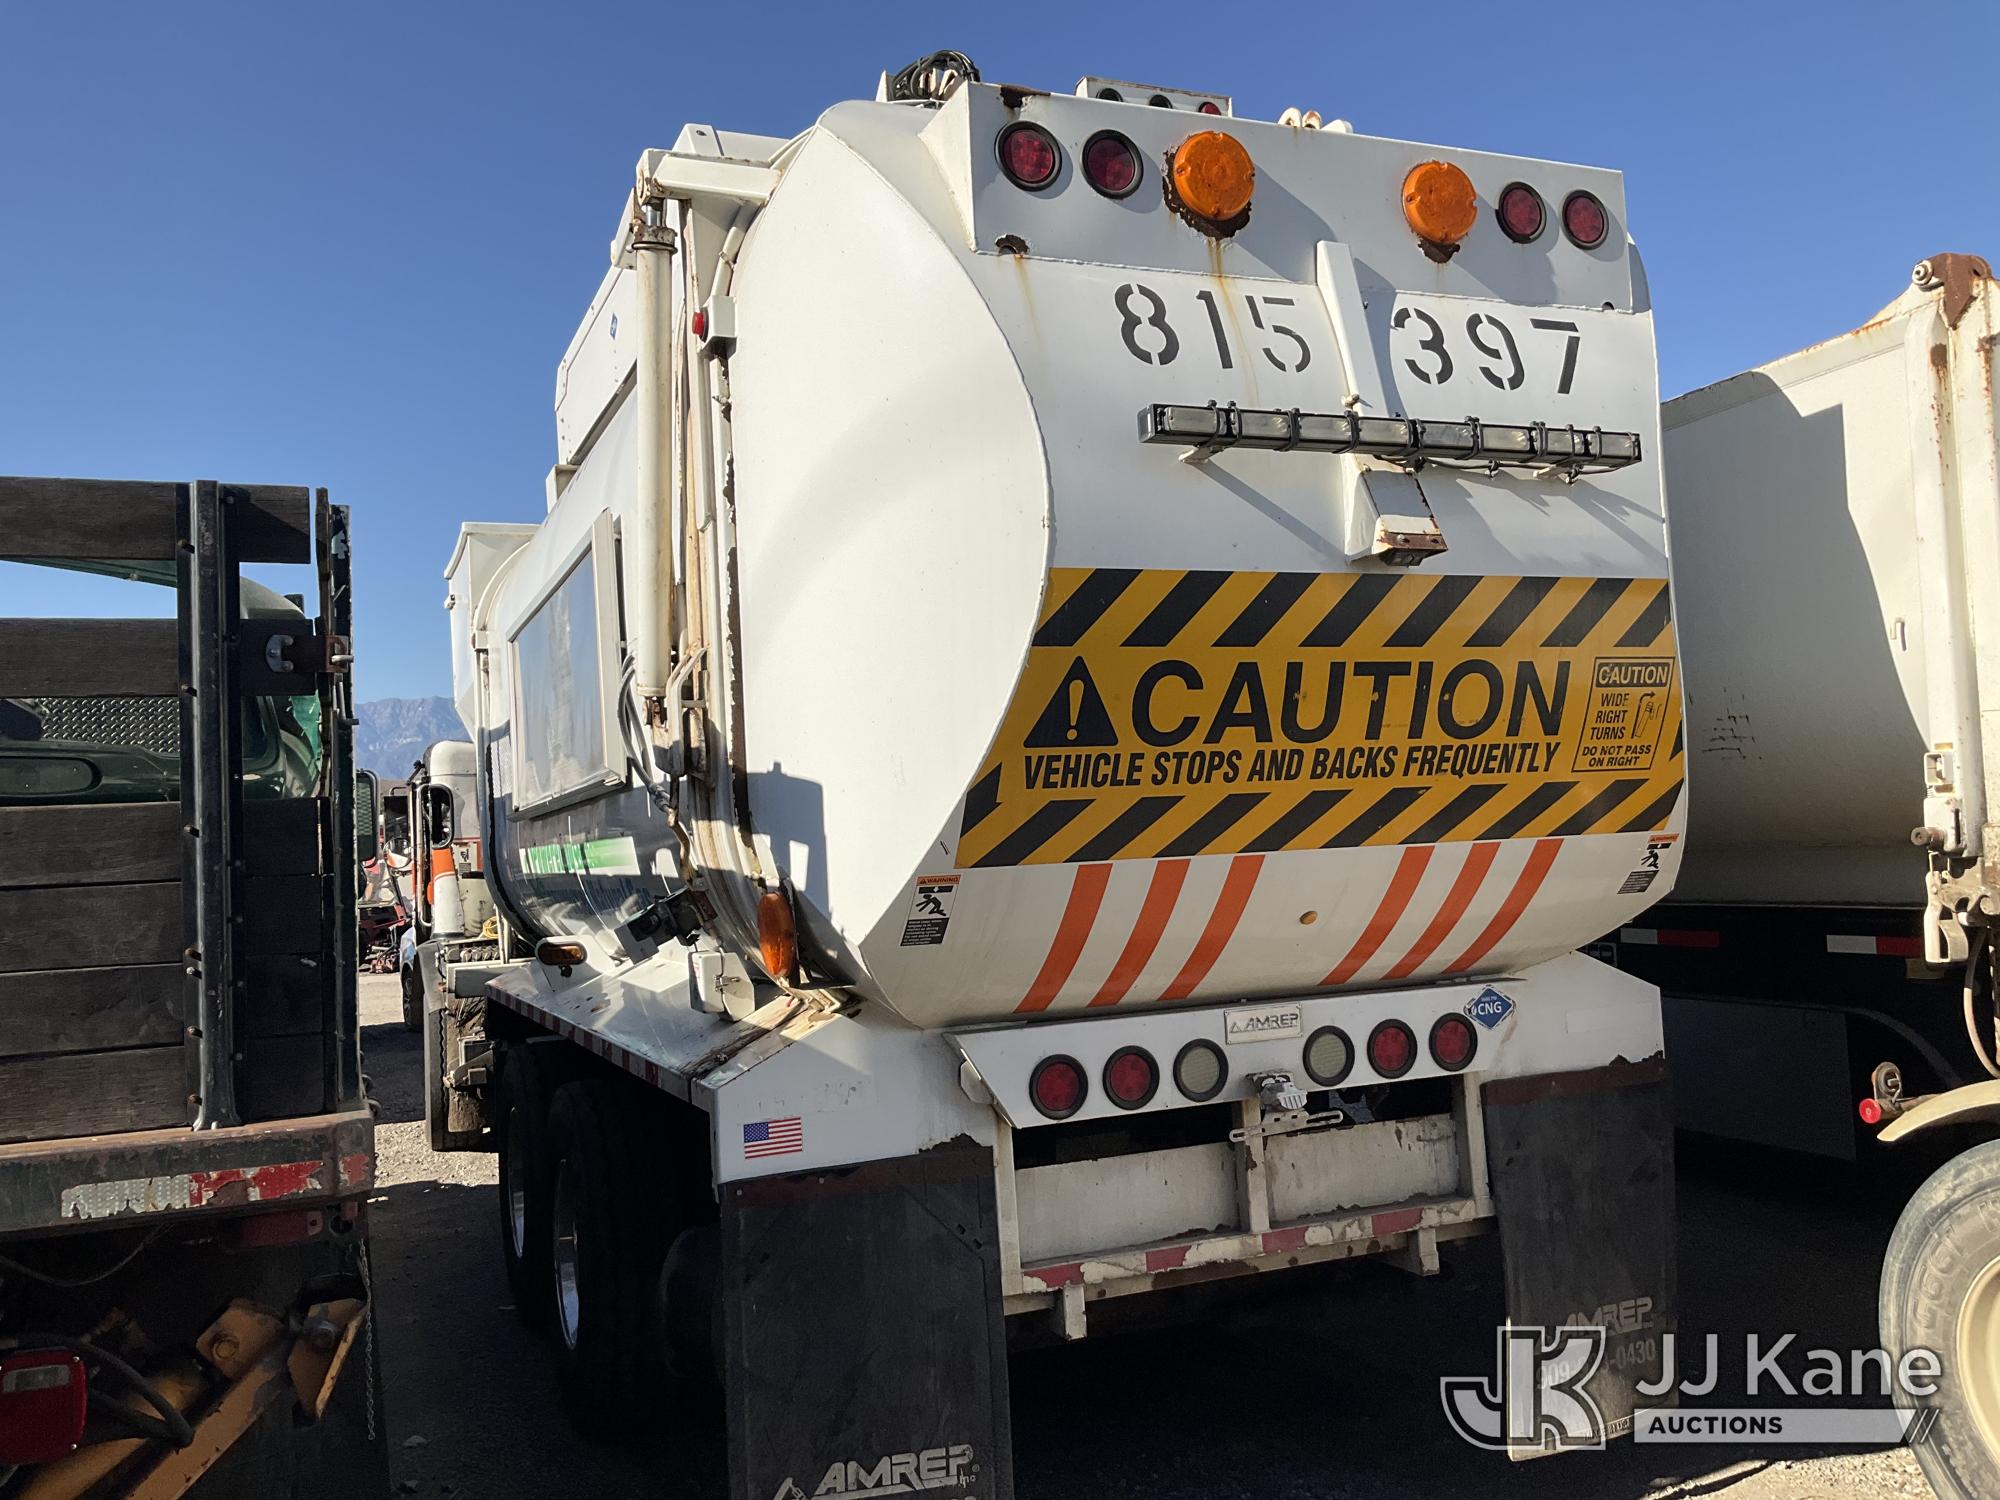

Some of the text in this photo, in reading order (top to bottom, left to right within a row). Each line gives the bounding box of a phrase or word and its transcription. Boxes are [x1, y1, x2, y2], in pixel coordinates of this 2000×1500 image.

[1114, 283, 1579, 395] 815 397
[1598, 666, 1668, 684] CAUTION
[1131, 659, 1571, 747] CAUTION
[1600, 693, 1630, 707] WIDE
[1595, 710, 1628, 724] RIGHT
[1590, 726, 1626, 741] TURNS
[1582, 744, 1652, 756] DO NOT PASS
[1024, 742, 1561, 789] VEHICLE STOPS AND BACKS FREQUENTLY
[1588, 756, 1640, 767] ON RIGHT
[1478, 1001, 1502, 1015] CNG
[1246, 1013, 1299, 1031] AMREP
[814, 1444, 974, 1496] AMREP
